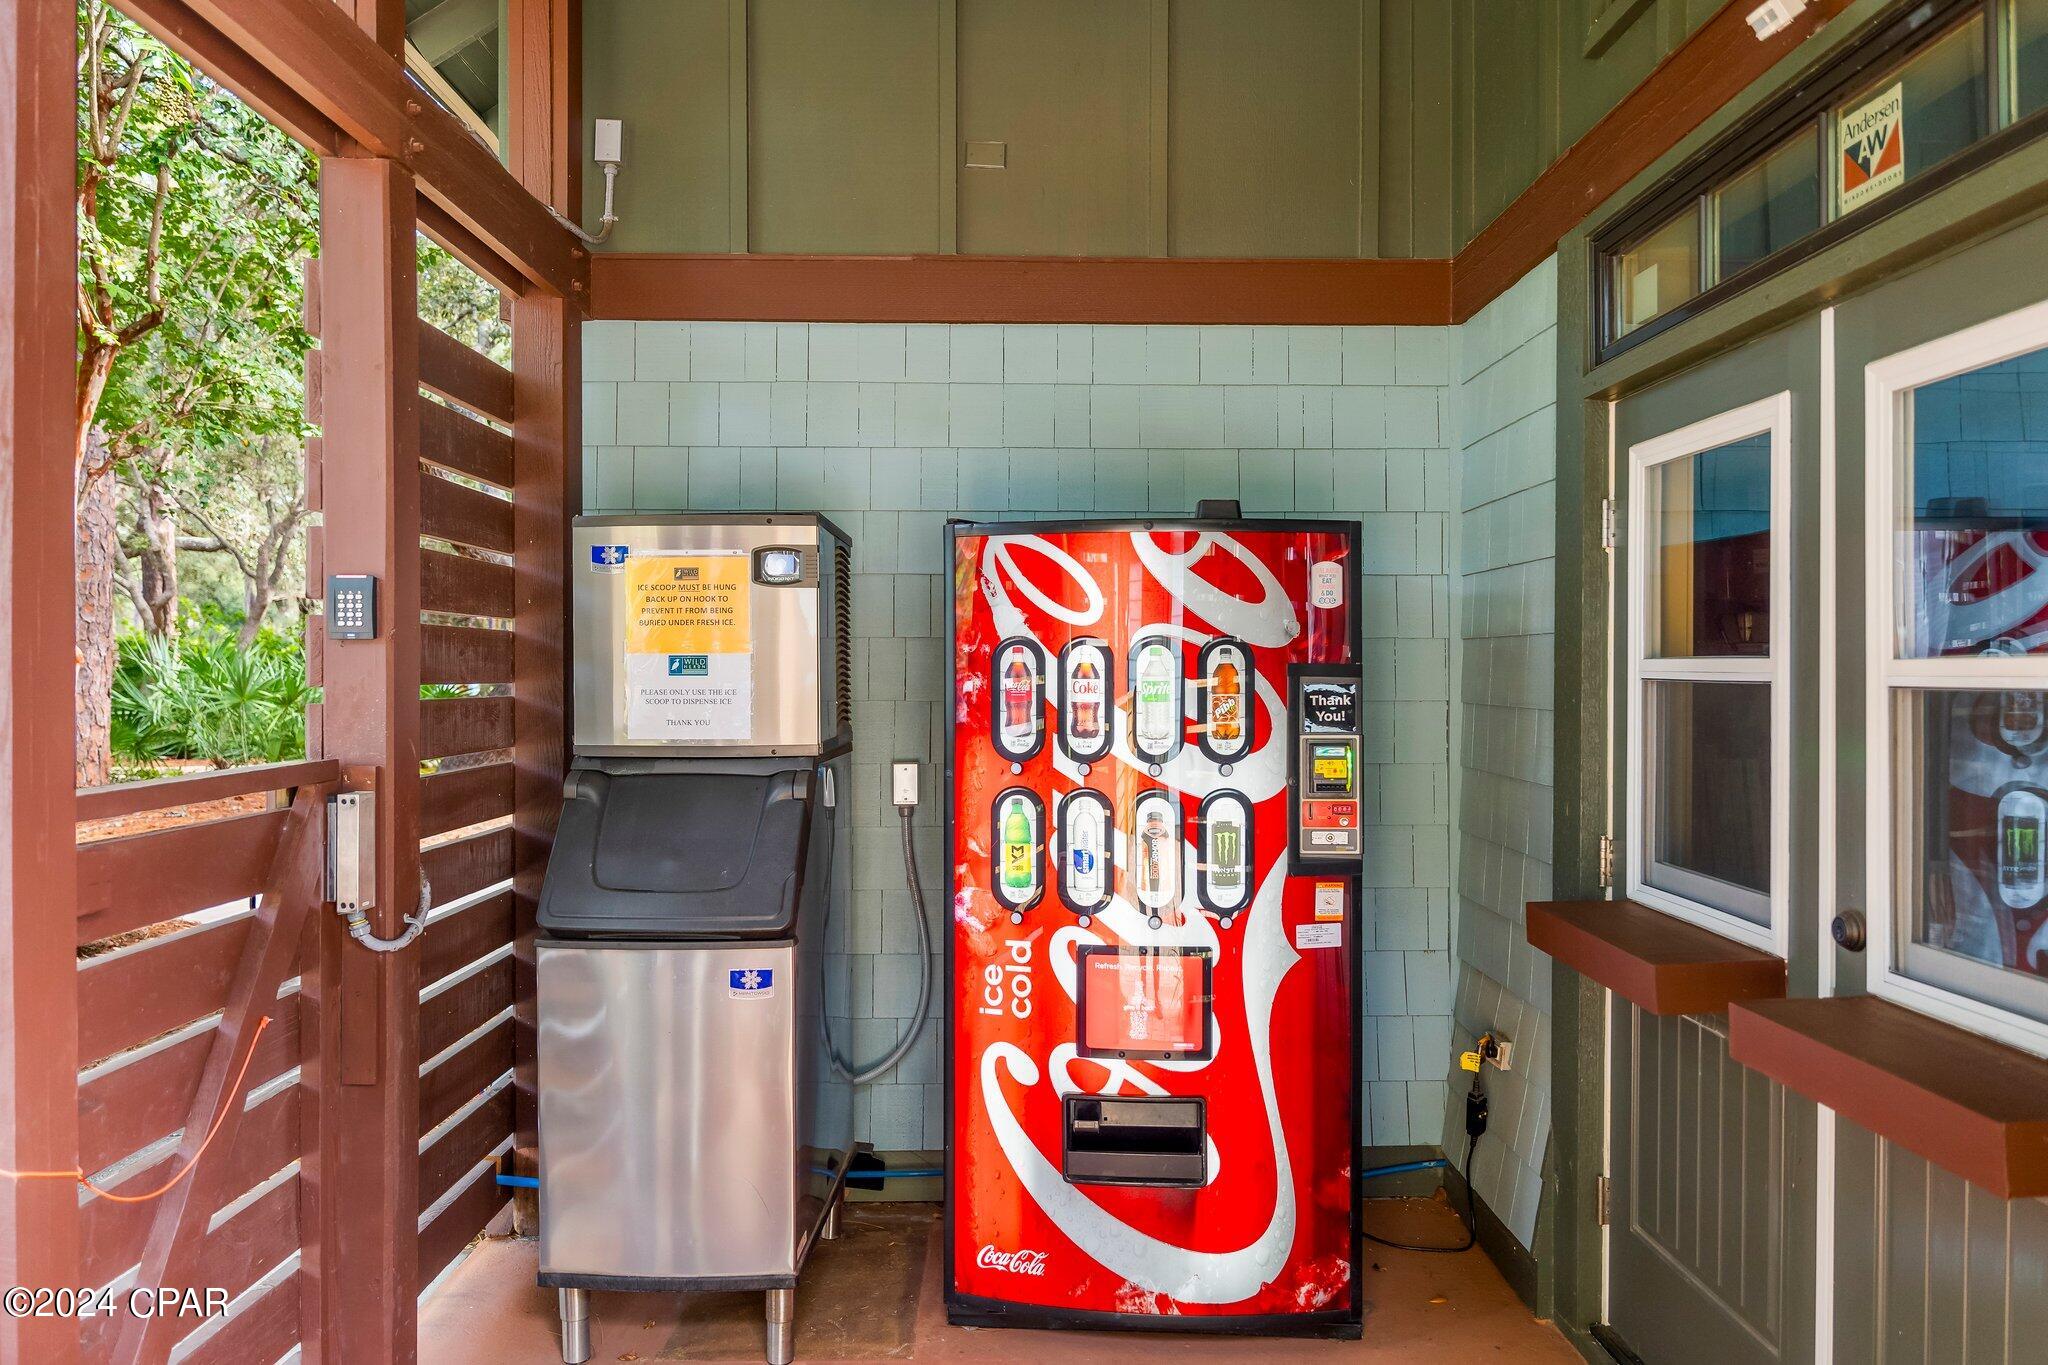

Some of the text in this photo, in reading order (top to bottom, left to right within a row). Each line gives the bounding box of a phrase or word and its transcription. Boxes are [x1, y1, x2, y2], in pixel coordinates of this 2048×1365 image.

[1843, 98, 1899, 143] Andersen
[1857, 124, 1888, 165] AW
[639, 619, 667, 627] BURIED
[1072, 681, 1099, 694] Coke
[1310, 693, 1352, 707] Thank
[1316, 711, 1346, 722] You!
[979, 963, 1004, 1016] ice
[1004, 940, 1033, 1020] cold
[976, 1244, 1050, 1277] Coca-Cola
